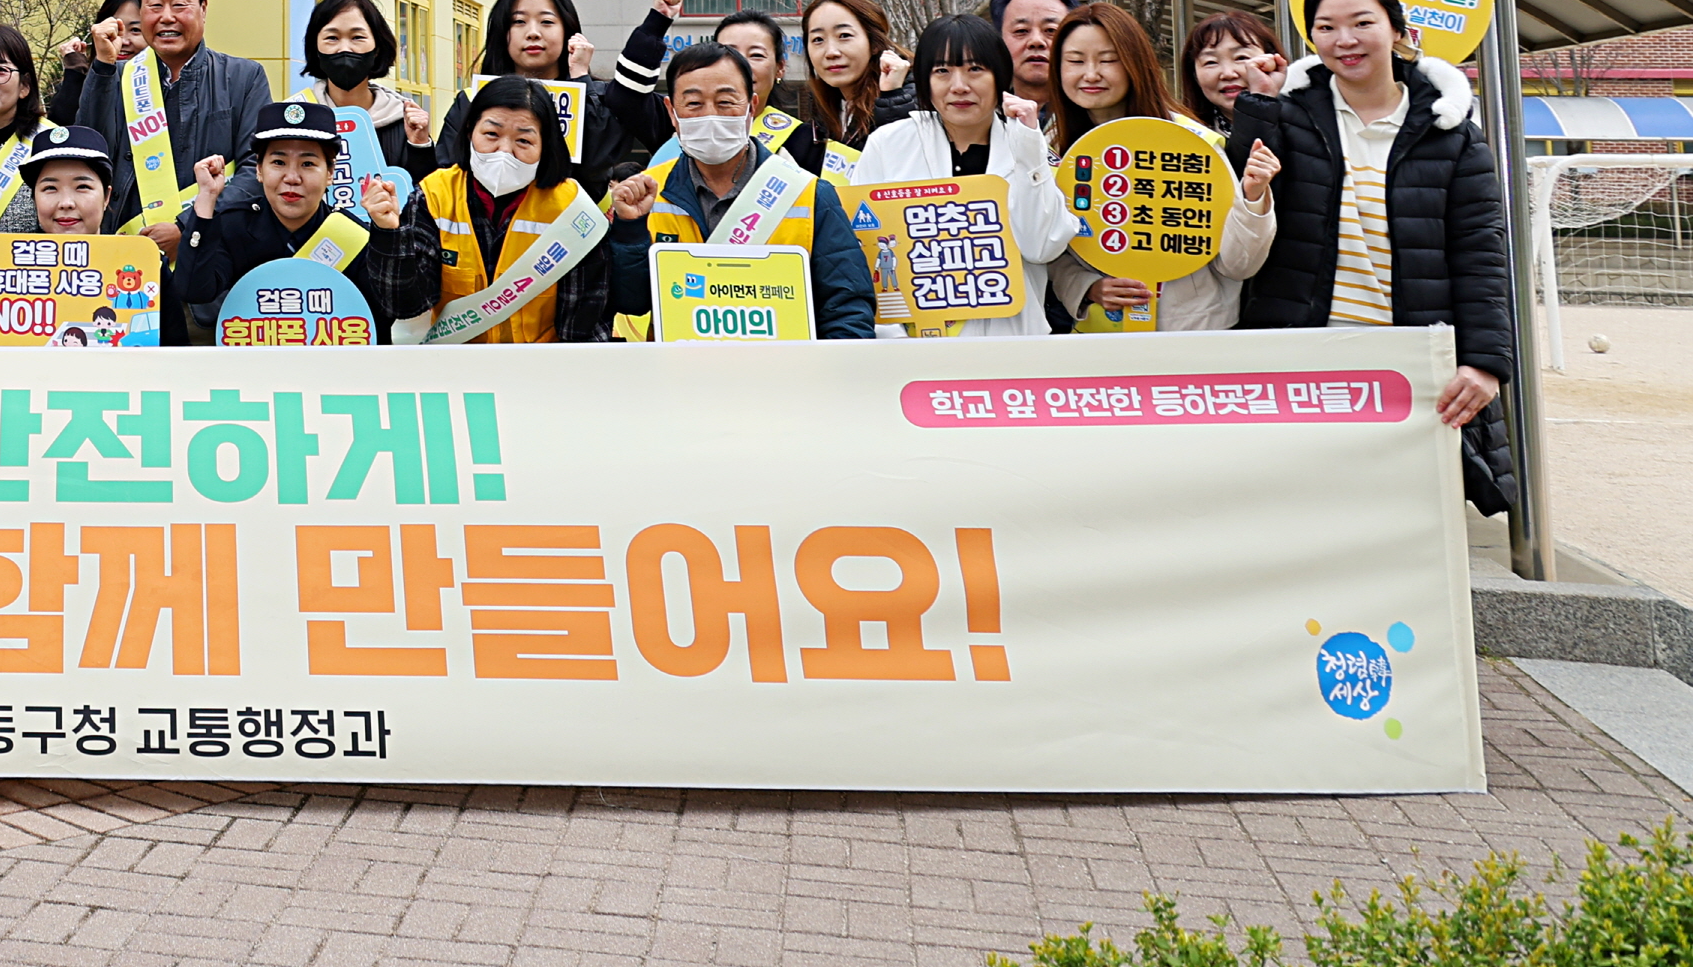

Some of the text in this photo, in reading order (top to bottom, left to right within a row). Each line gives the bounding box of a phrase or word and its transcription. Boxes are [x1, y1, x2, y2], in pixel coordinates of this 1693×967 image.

[1410, 7, 1463, 31] 실천이
[133, 65, 152, 113] 스마트폰
[128, 111, 169, 142] NO!
[4, 143, 29, 173] 걸을
[1160, 152, 1211, 174] 멈춤!
[756, 176, 788, 210] 매월
[883, 189, 912, 199] 신호등을
[914, 188, 922, 197] 잘
[1161, 180, 1212, 202] 저쪽!
[904, 200, 1003, 239] 멈추고
[1160, 207, 1211, 229] 동안!
[12, 240, 89, 267] 걸을 때
[533, 241, 569, 276] 매월
[908, 236, 1009, 274] 살피고
[1160, 233, 1212, 256] 예방!
[55, 269, 103, 297] 사용
[481, 277, 534, 315] 4일은
[710, 284, 795, 300] 아이먼저 캠페인
[911, 271, 1012, 310] 건너요
[257, 288, 332, 314] 걸을 때
[222, 316, 371, 345] 휴대폰 사용
[695, 308, 774, 336] 아이의
[929, 381, 1383, 420] 학교 앞 안전한 등하굣길 만들기
[295, 522, 1012, 684] 만들어요!
[1329, 679, 1379, 711] 세상
[137, 706, 392, 759] 교통행정과
